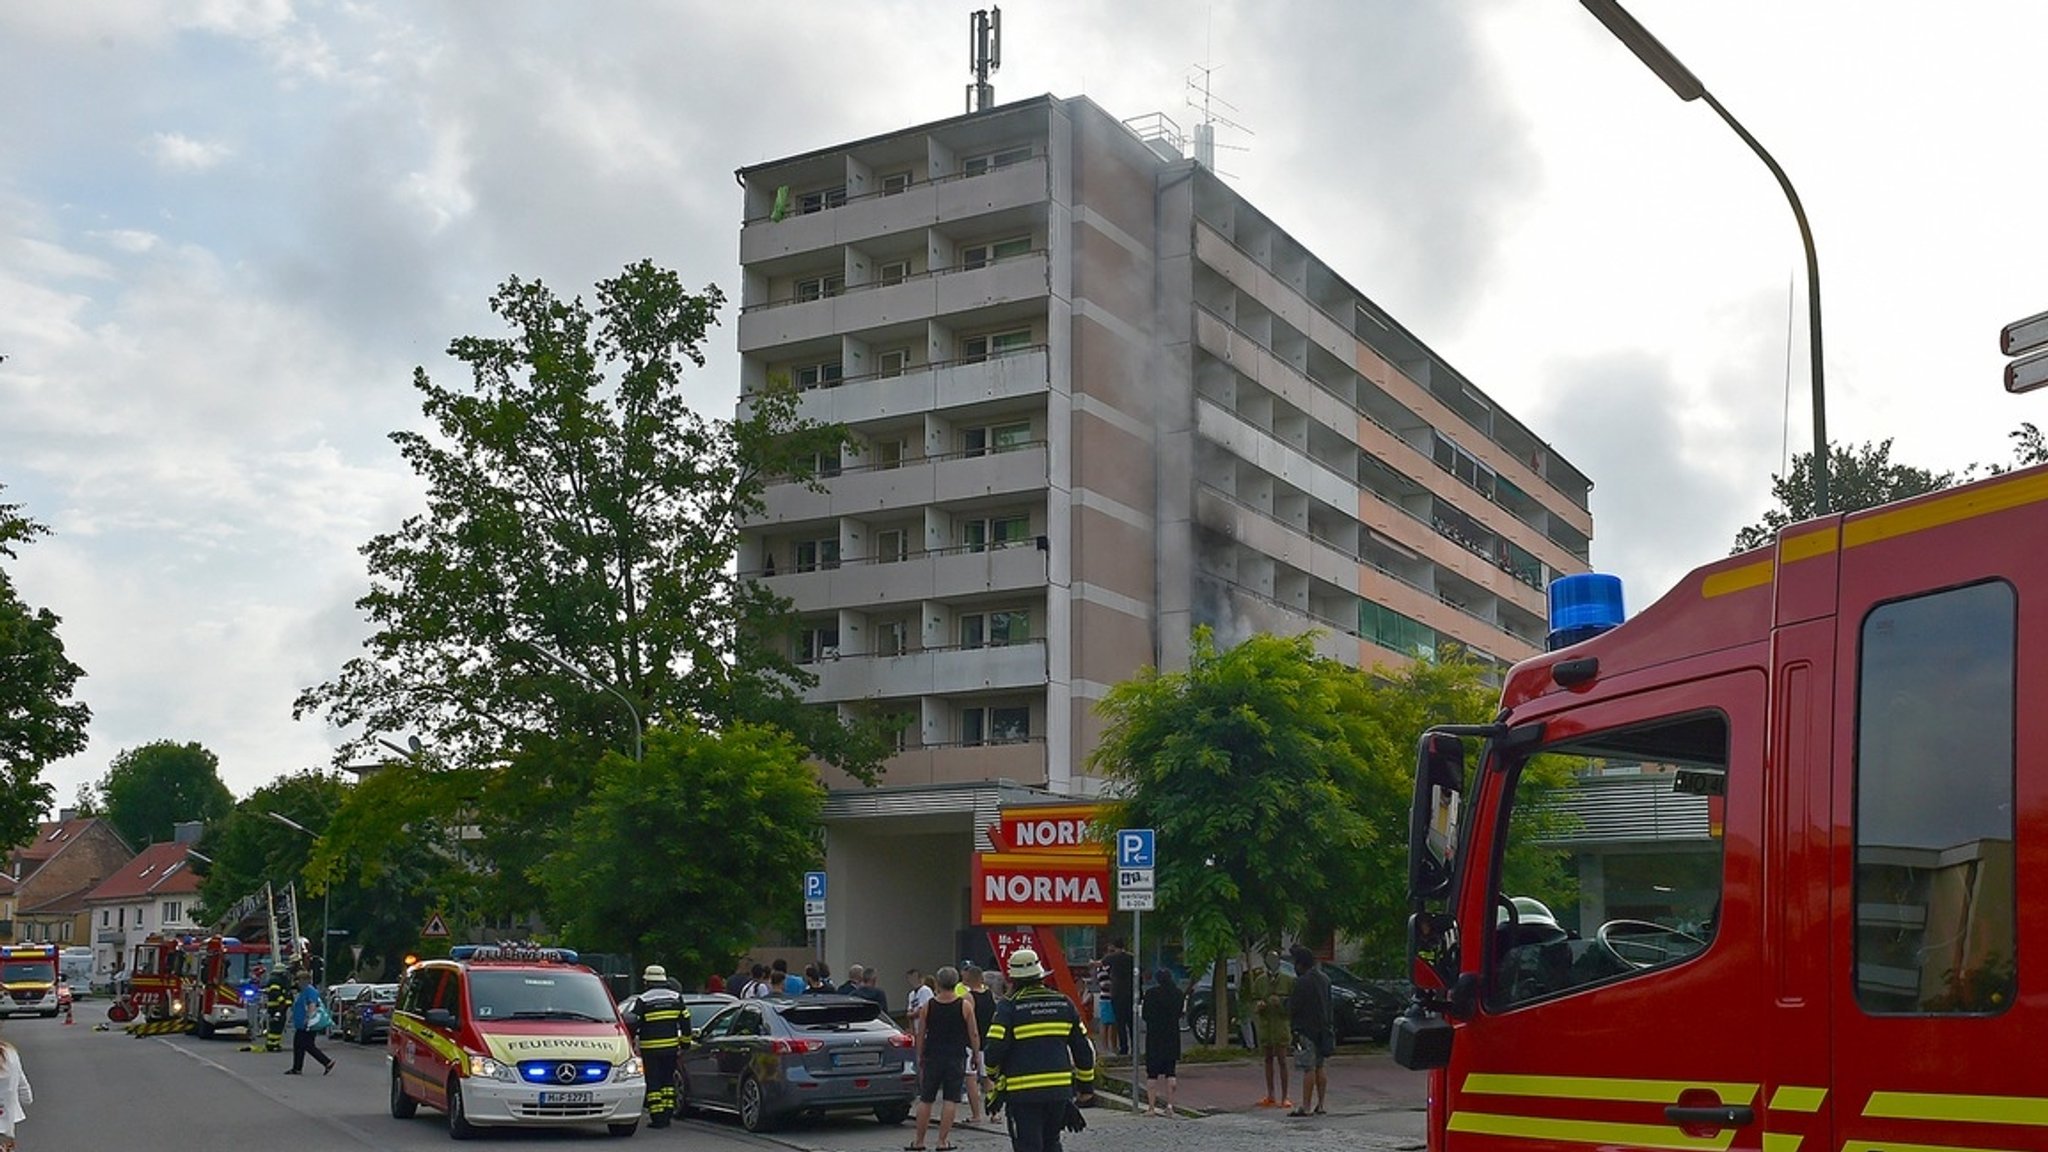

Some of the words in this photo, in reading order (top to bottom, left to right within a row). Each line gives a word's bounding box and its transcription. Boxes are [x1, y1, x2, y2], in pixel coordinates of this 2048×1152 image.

[1124, 834, 1143, 863] P
[808, 876, 820, 896] P
[985, 875, 1104, 903] NORMA
[477, 948, 560, 961] FEUERWEHR
[999, 944, 1008, 958] 7
[508, 1039, 614, 1052] FEUERWEHR
